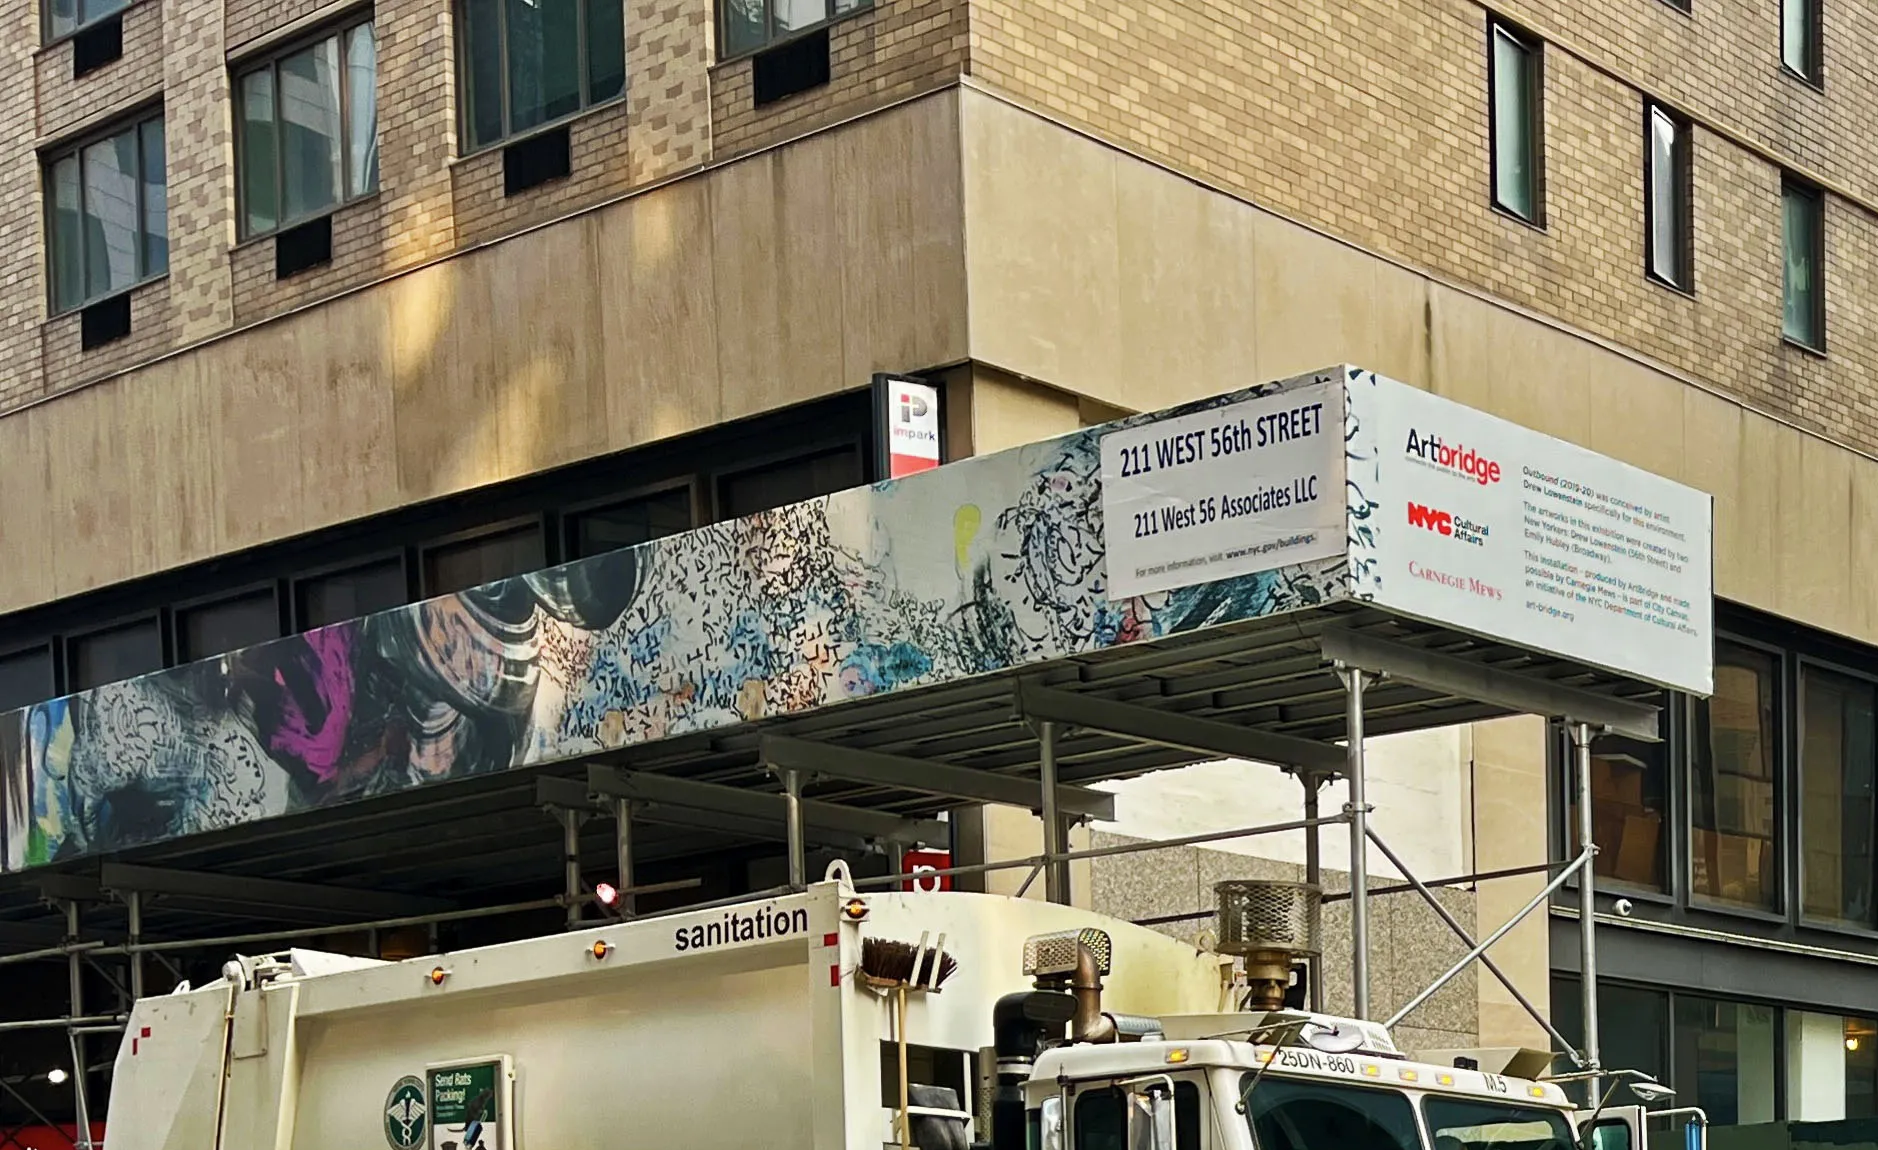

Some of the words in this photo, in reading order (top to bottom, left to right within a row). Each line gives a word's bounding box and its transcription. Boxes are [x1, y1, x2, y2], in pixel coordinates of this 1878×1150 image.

[893, 425, 935, 441] impark
[1120, 444, 1151, 477] 211
[1156, 431, 1205, 469] WEST
[1211, 419, 1251, 457] 56th
[1256, 403, 1323, 447] STREET
[1406, 428, 1500, 485] Artbridge
[1134, 510, 1158, 538] 211
[1161, 503, 1196, 532] West
[1199, 497, 1215, 524] 56
[1221, 487, 1290, 520] Associates
[1294, 475, 1318, 504] LLC
[1407, 501, 1452, 536] NYC
[1454, 516, 1489, 537] Cultural
[1454, 529, 1484, 547] Affairs
[674, 906, 809, 951] sanitation
[1278, 1050, 1355, 1074] 25DN-860
[1482, 1073, 1508, 1093] M.5
